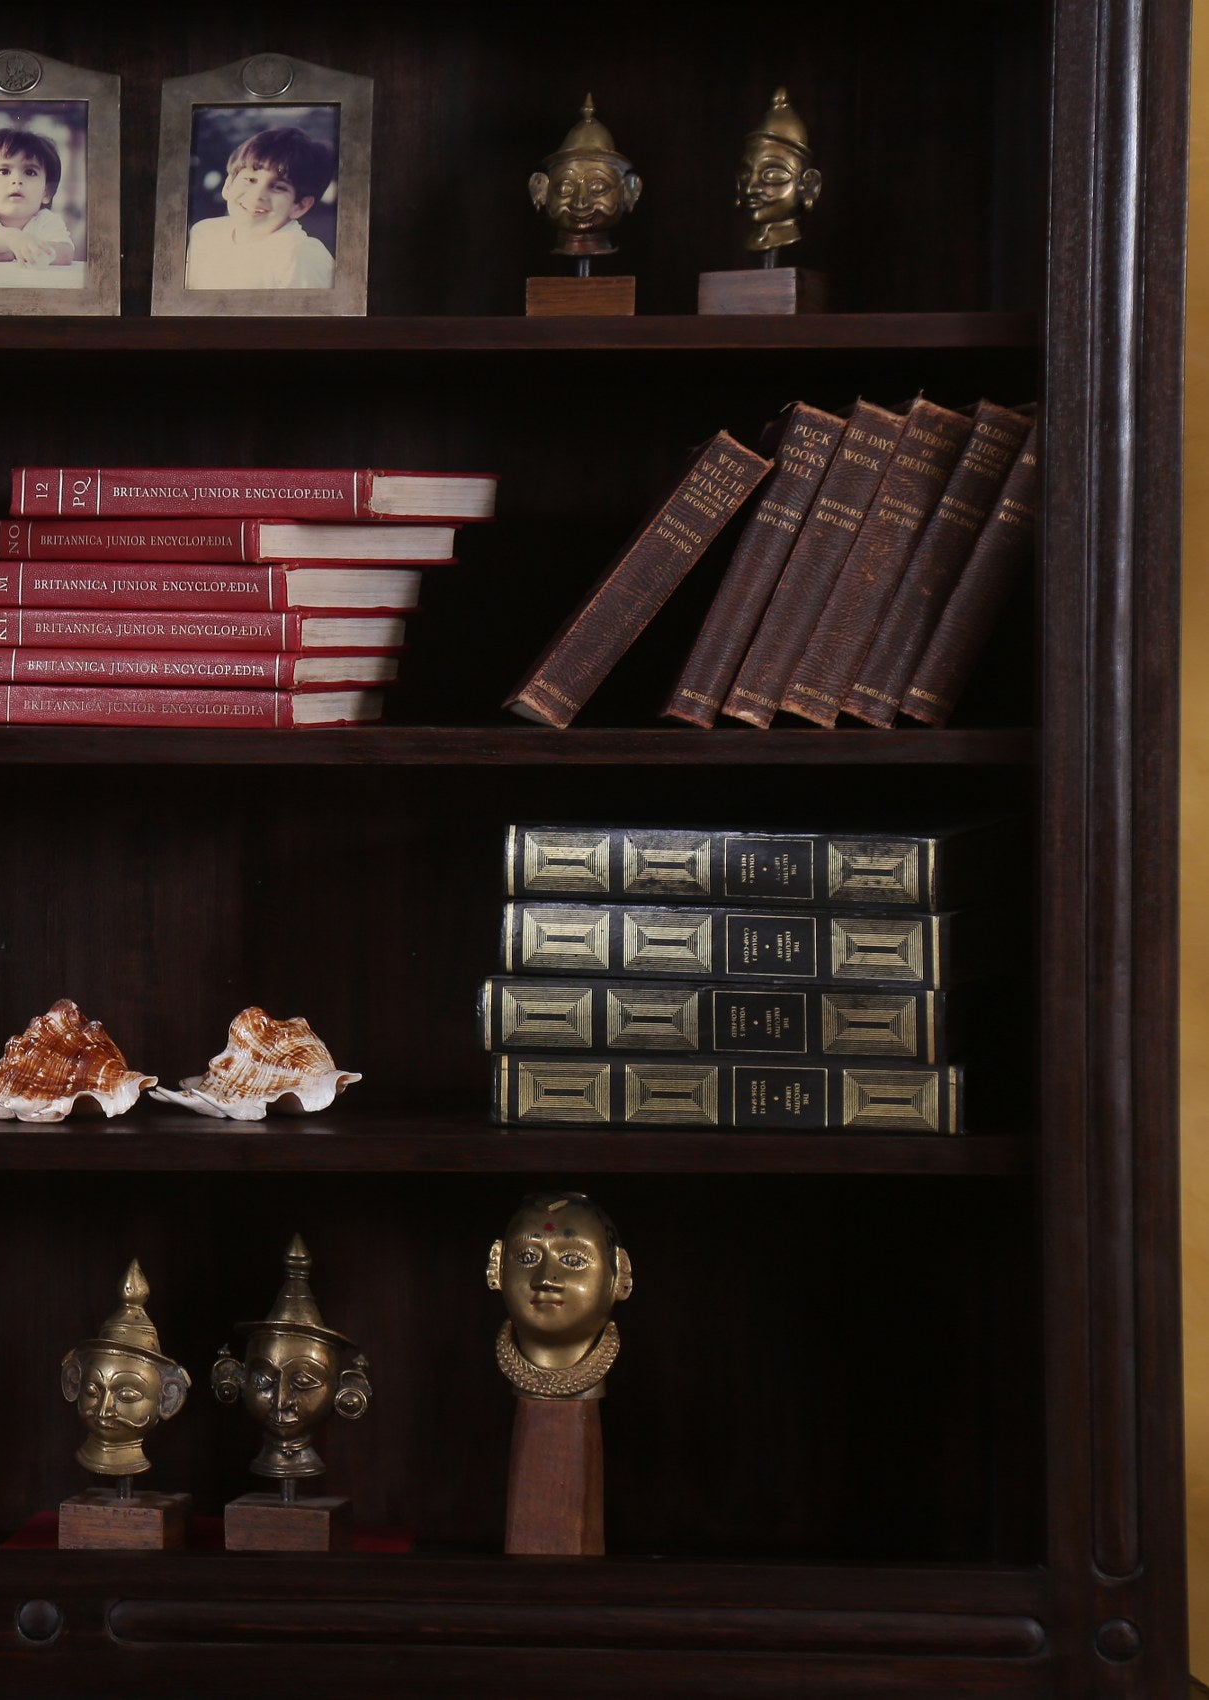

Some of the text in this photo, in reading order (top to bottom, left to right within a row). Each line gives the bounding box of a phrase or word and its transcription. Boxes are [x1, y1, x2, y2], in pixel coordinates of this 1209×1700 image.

[793, 424, 832, 446] PUCK
[845, 427, 867, 442] HE
[717, 453, 745, 477] WEE
[781, 443, 827, 468] POOK'S
[843, 448, 880, 471] WORK
[922, 449, 935, 459] OF
[701, 461, 745, 496] WILLIE
[781, 460, 812, 481] HILL
[35, 482, 49, 499] 12
[72, 476, 92, 507] PQ
[113, 486, 344, 501] BRITANNICA JUNIOR ENCYCLOPÆDIA
[689, 486, 702, 497] AND
[690, 471, 737, 509] WINKIE
[682, 492, 718, 520] STORIES
[761, 499, 803, 521] RUDYARD
[820, 498, 865, 519] RUDYARD
[882, 495, 926, 519] RUDYARD
[941, 495, 985, 520] RUDYARD
[663, 514, 702, 544] RUDYARD
[756, 512, 797, 533] KIPLING
[816, 510, 857, 532] KIPLING
[878, 508, 919, 531] KIPLING
[938, 509, 978, 531] KIPLING
[8, 524, 20, 554] NO
[40, 535, 233, 548] BRITANNICA JUNIOR ENCYCLOPÆDIA
[656, 526, 693, 554] KIPLING
[33, 579, 260, 593] BRITANNICA JUNIOR ENCYCLOPÆDIA
[35, 623, 272, 637] BRITANNICA JUNIOR ENCYCLOPÆDIA
[27, 660, 265, 677] BRITANNICA JUNIOR ENCYCLOPÆDIA
[23, 699, 102, 712] BRITANNICA
[106, 701, 156, 715] JUNIOR
